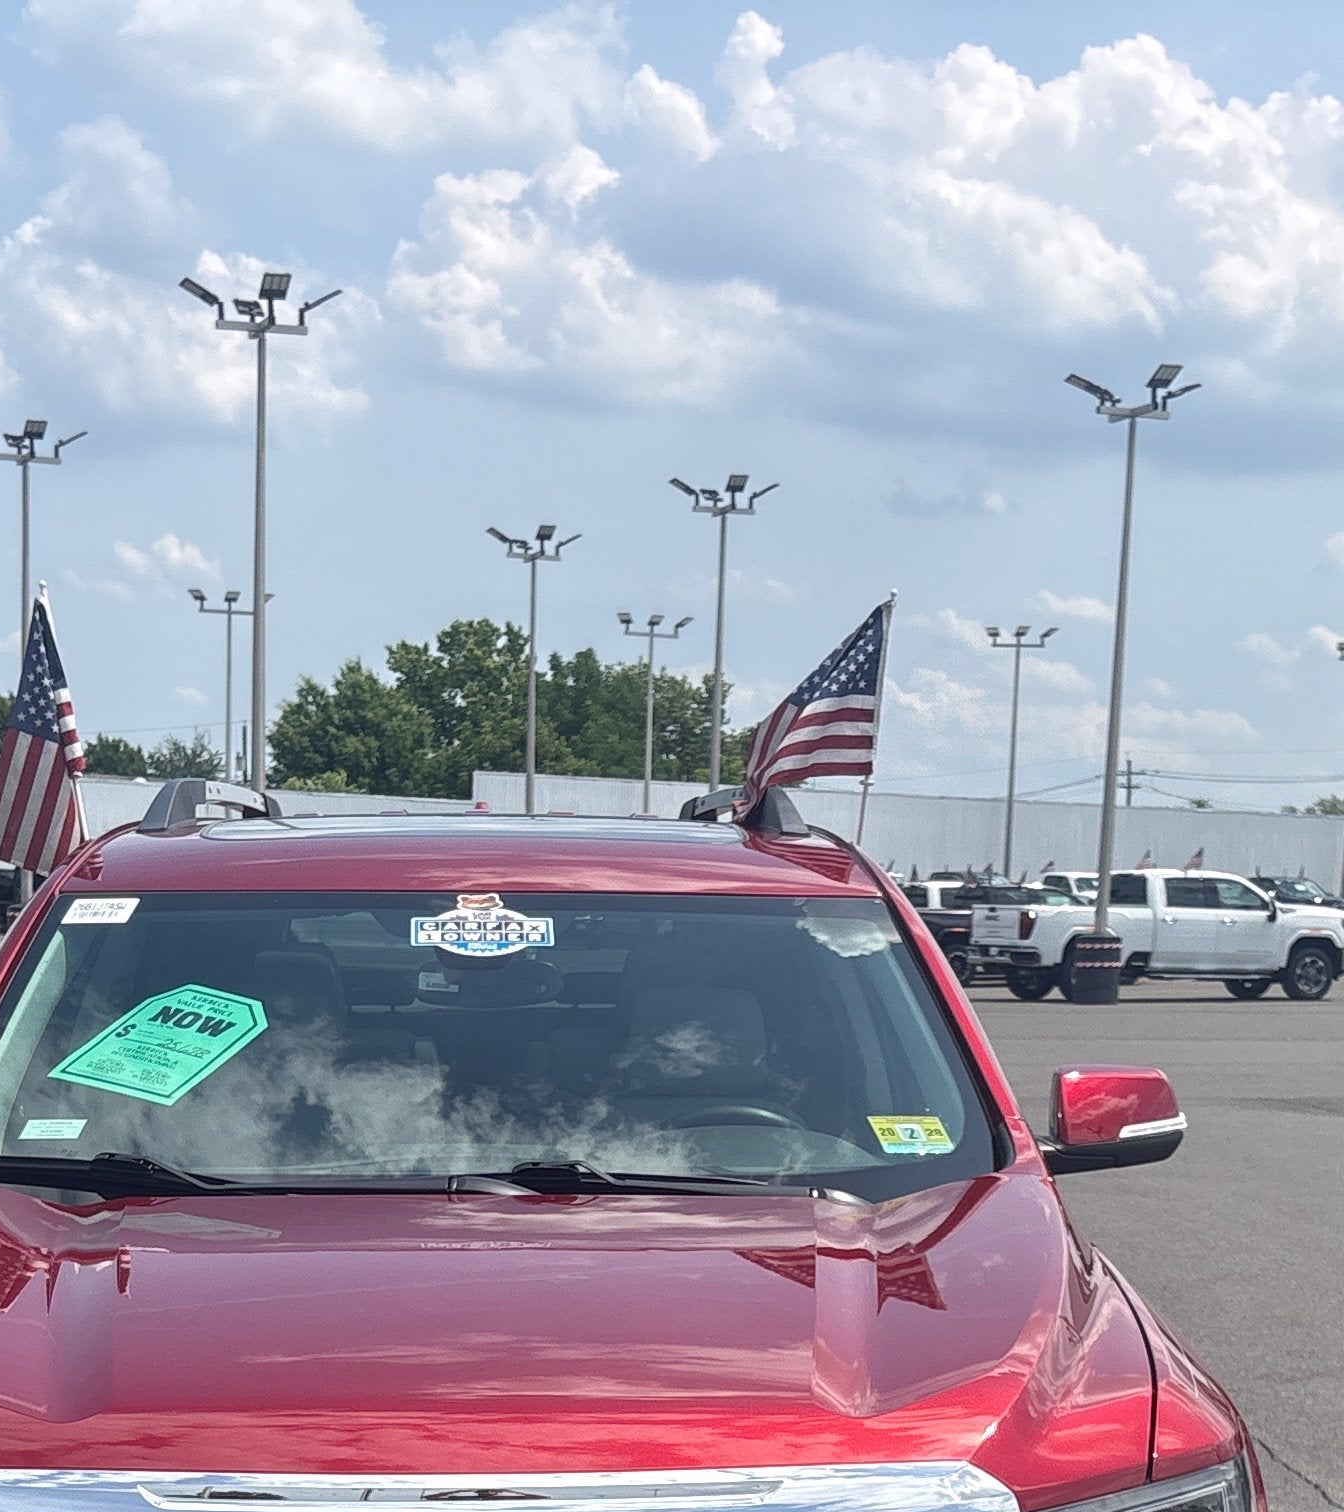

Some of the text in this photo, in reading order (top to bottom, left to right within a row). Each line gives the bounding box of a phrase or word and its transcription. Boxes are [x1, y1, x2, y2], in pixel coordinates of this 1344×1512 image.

[420, 921, 545, 932] CARFAX
[442, 932, 544, 942] OWNER
[146, 1005, 238, 1038] NOW
[114, 1023, 138, 1039] $
[878, 1127, 897, 1138] 20
[903, 1127, 920, 1140] 2
